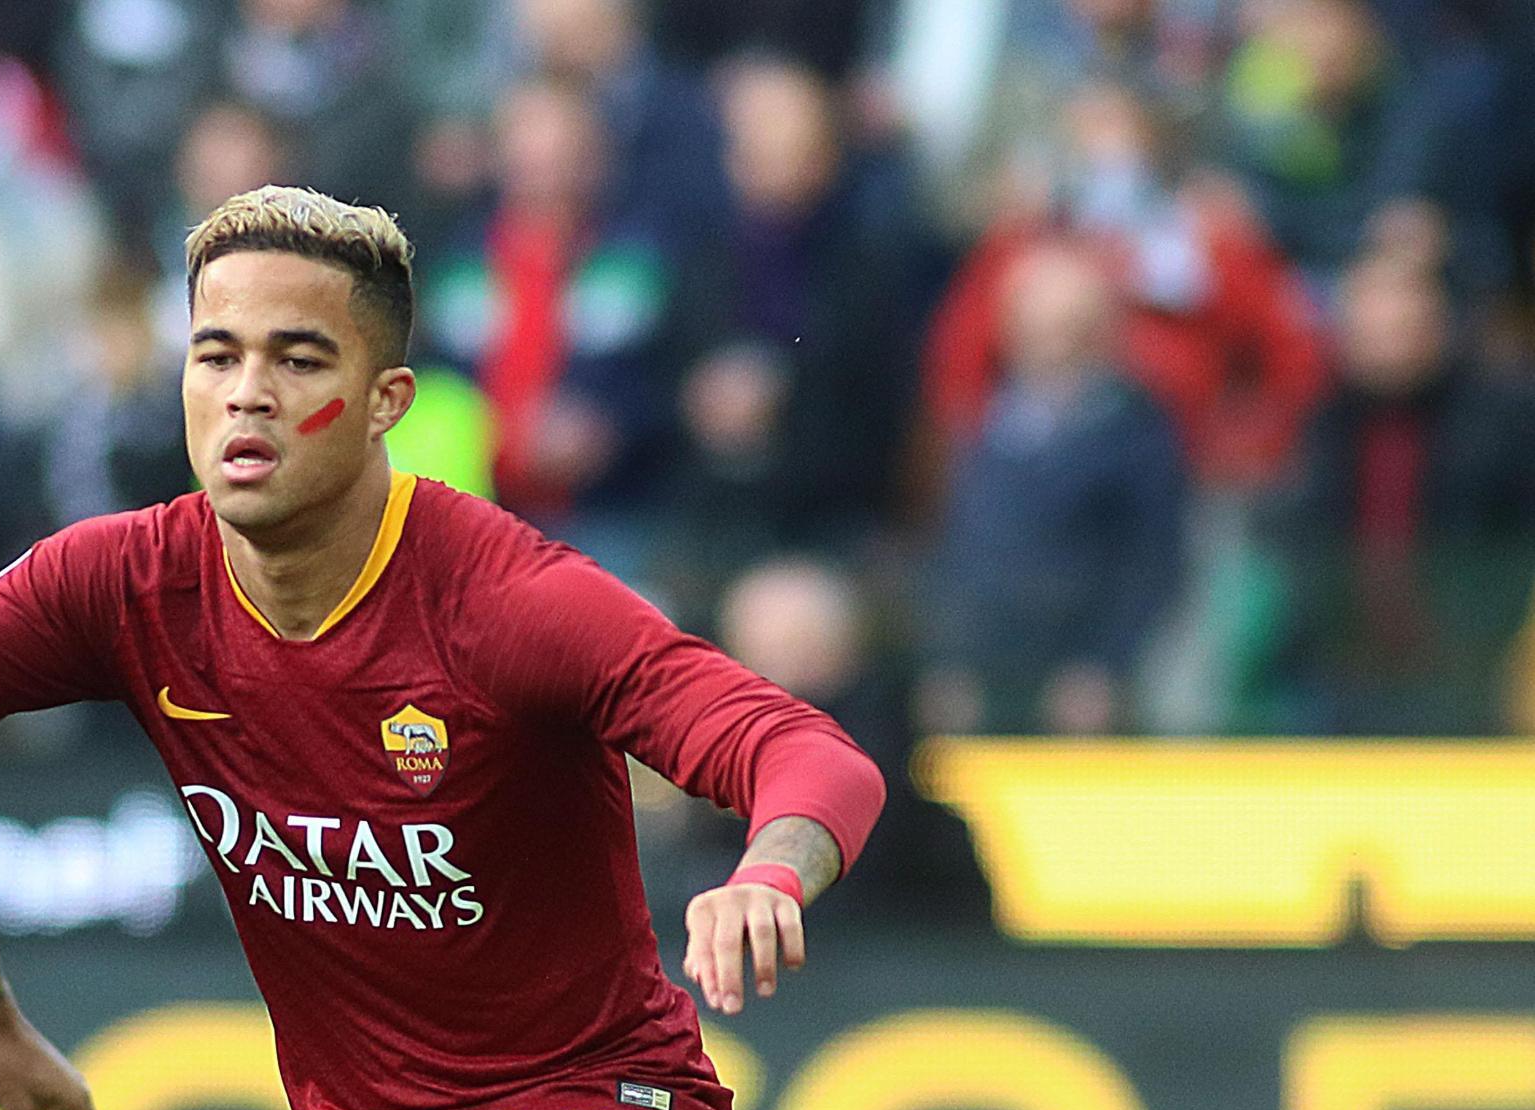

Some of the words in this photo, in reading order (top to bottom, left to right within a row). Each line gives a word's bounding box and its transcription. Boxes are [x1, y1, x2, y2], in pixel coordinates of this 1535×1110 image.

[395, 756, 444, 771] ROMA
[181, 785, 472, 887] QATAR
[249, 874, 484, 930] AIRWAYS
